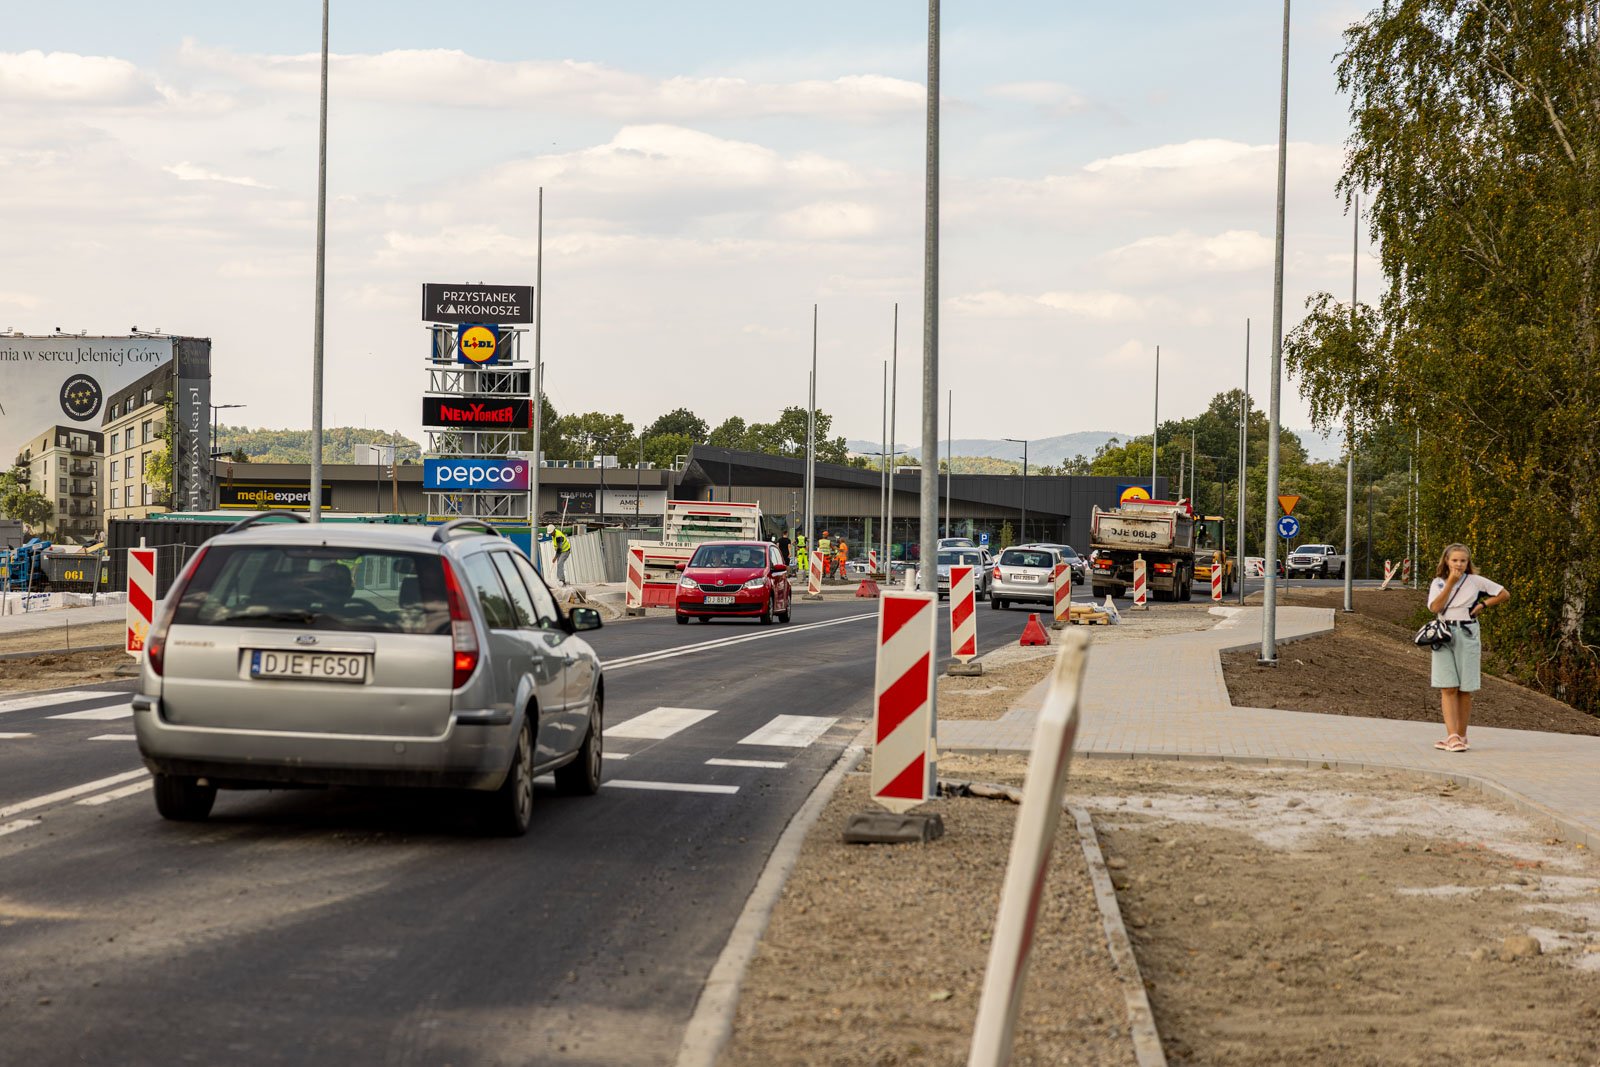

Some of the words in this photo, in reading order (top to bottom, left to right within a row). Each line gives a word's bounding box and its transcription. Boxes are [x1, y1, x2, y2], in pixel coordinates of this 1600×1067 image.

[443, 291, 516, 303] PRZYSTANEK
[436, 304, 521, 316] KARKONOSZE
[23, 351, 35, 361] w
[38, 352, 73, 362] sercu
[75, 347, 124, 367] Jeleniej
[127, 347, 163, 367] Góry
[559, 491, 594, 499] TRAFIKA
[981, 534, 988, 542] P
[64, 570, 84, 580] 061
[265, 654, 303, 674] DJE
[309, 656, 361, 677] FG50
